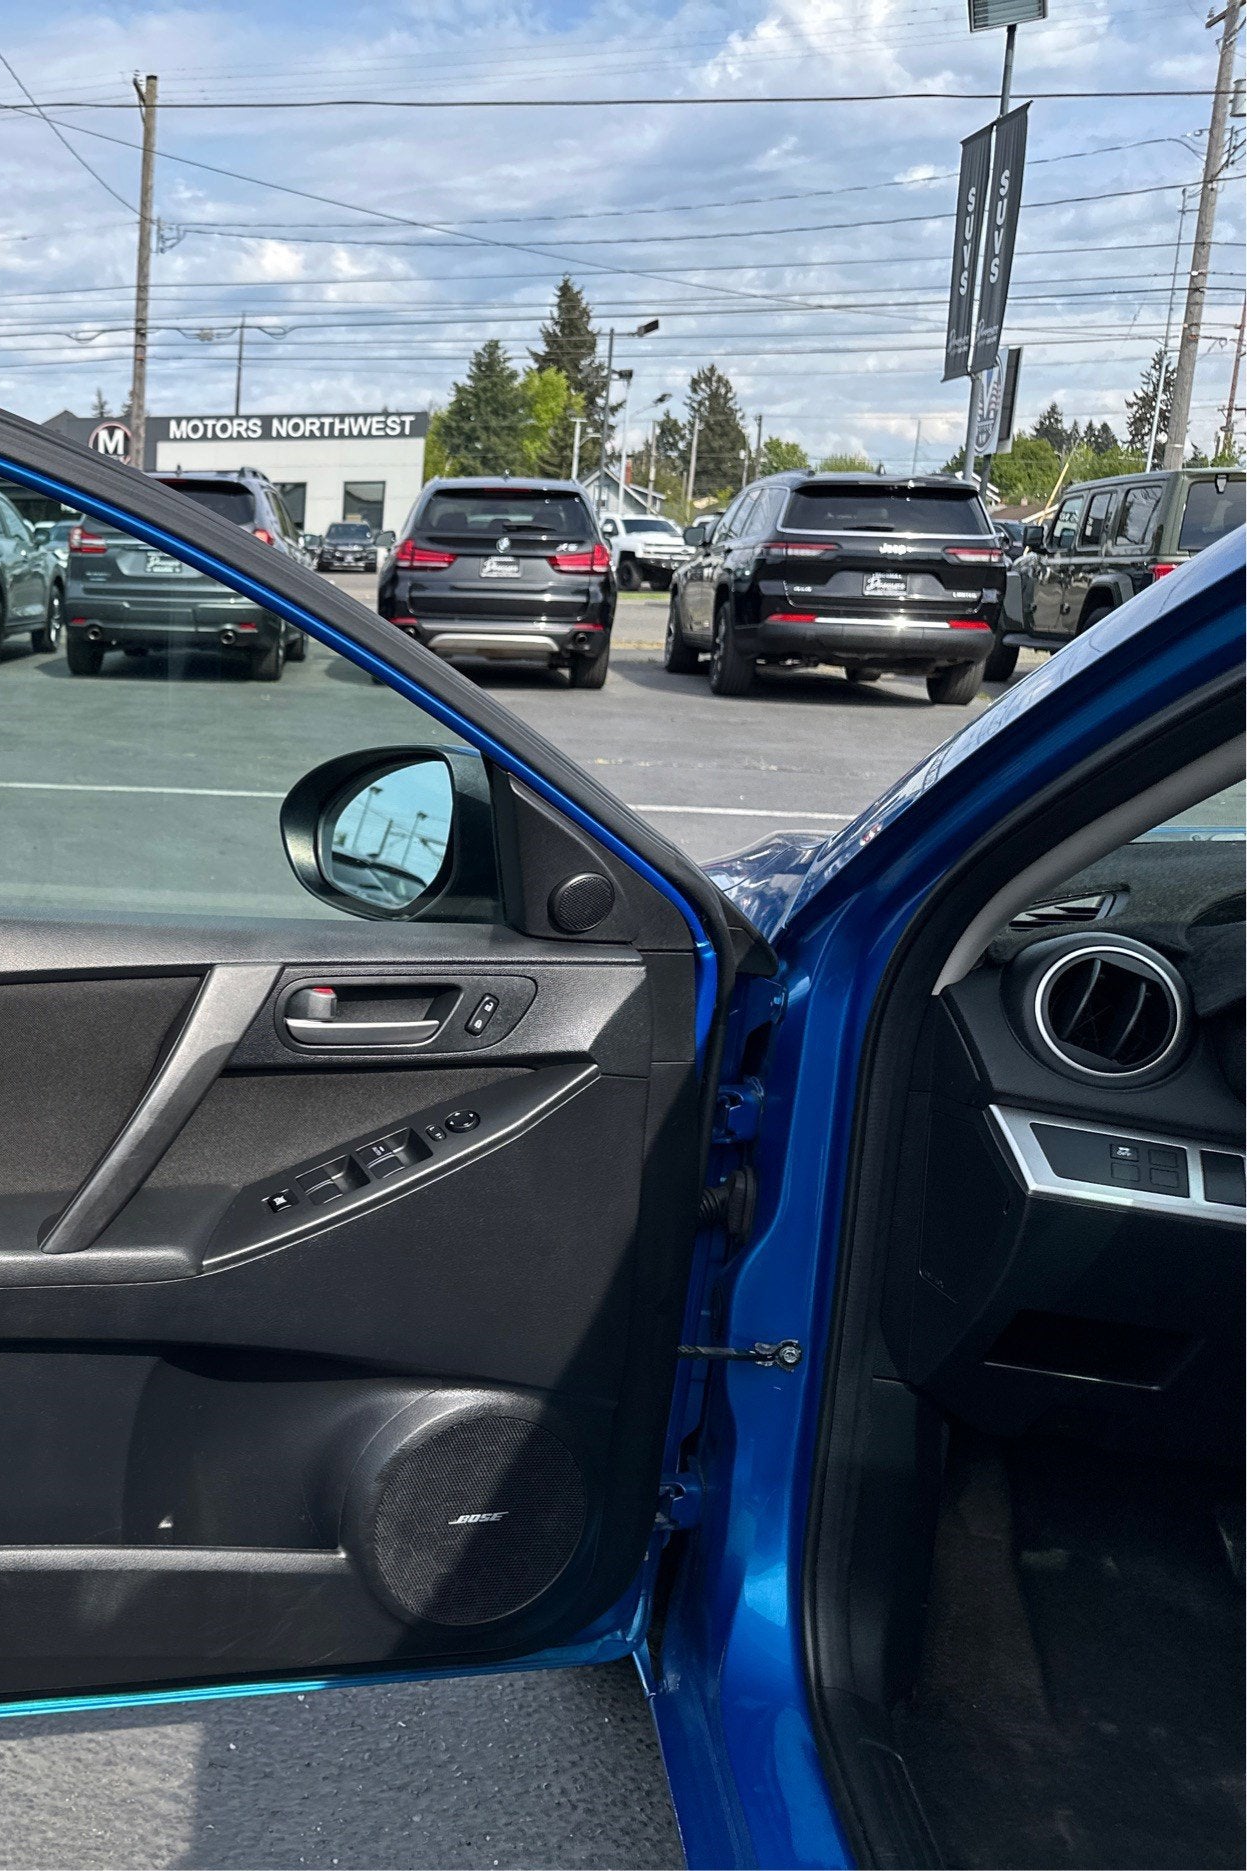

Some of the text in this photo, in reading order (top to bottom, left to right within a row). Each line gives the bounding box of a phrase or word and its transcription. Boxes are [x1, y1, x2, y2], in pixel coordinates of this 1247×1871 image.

[989, 169, 1010, 284] SUVS
[959, 186, 977, 296] SUVS
[168, 415, 416, 440] MOTORS NORTHWEST
[97, 428, 125, 455] M
[448, 1511, 509, 1525] BOSE
